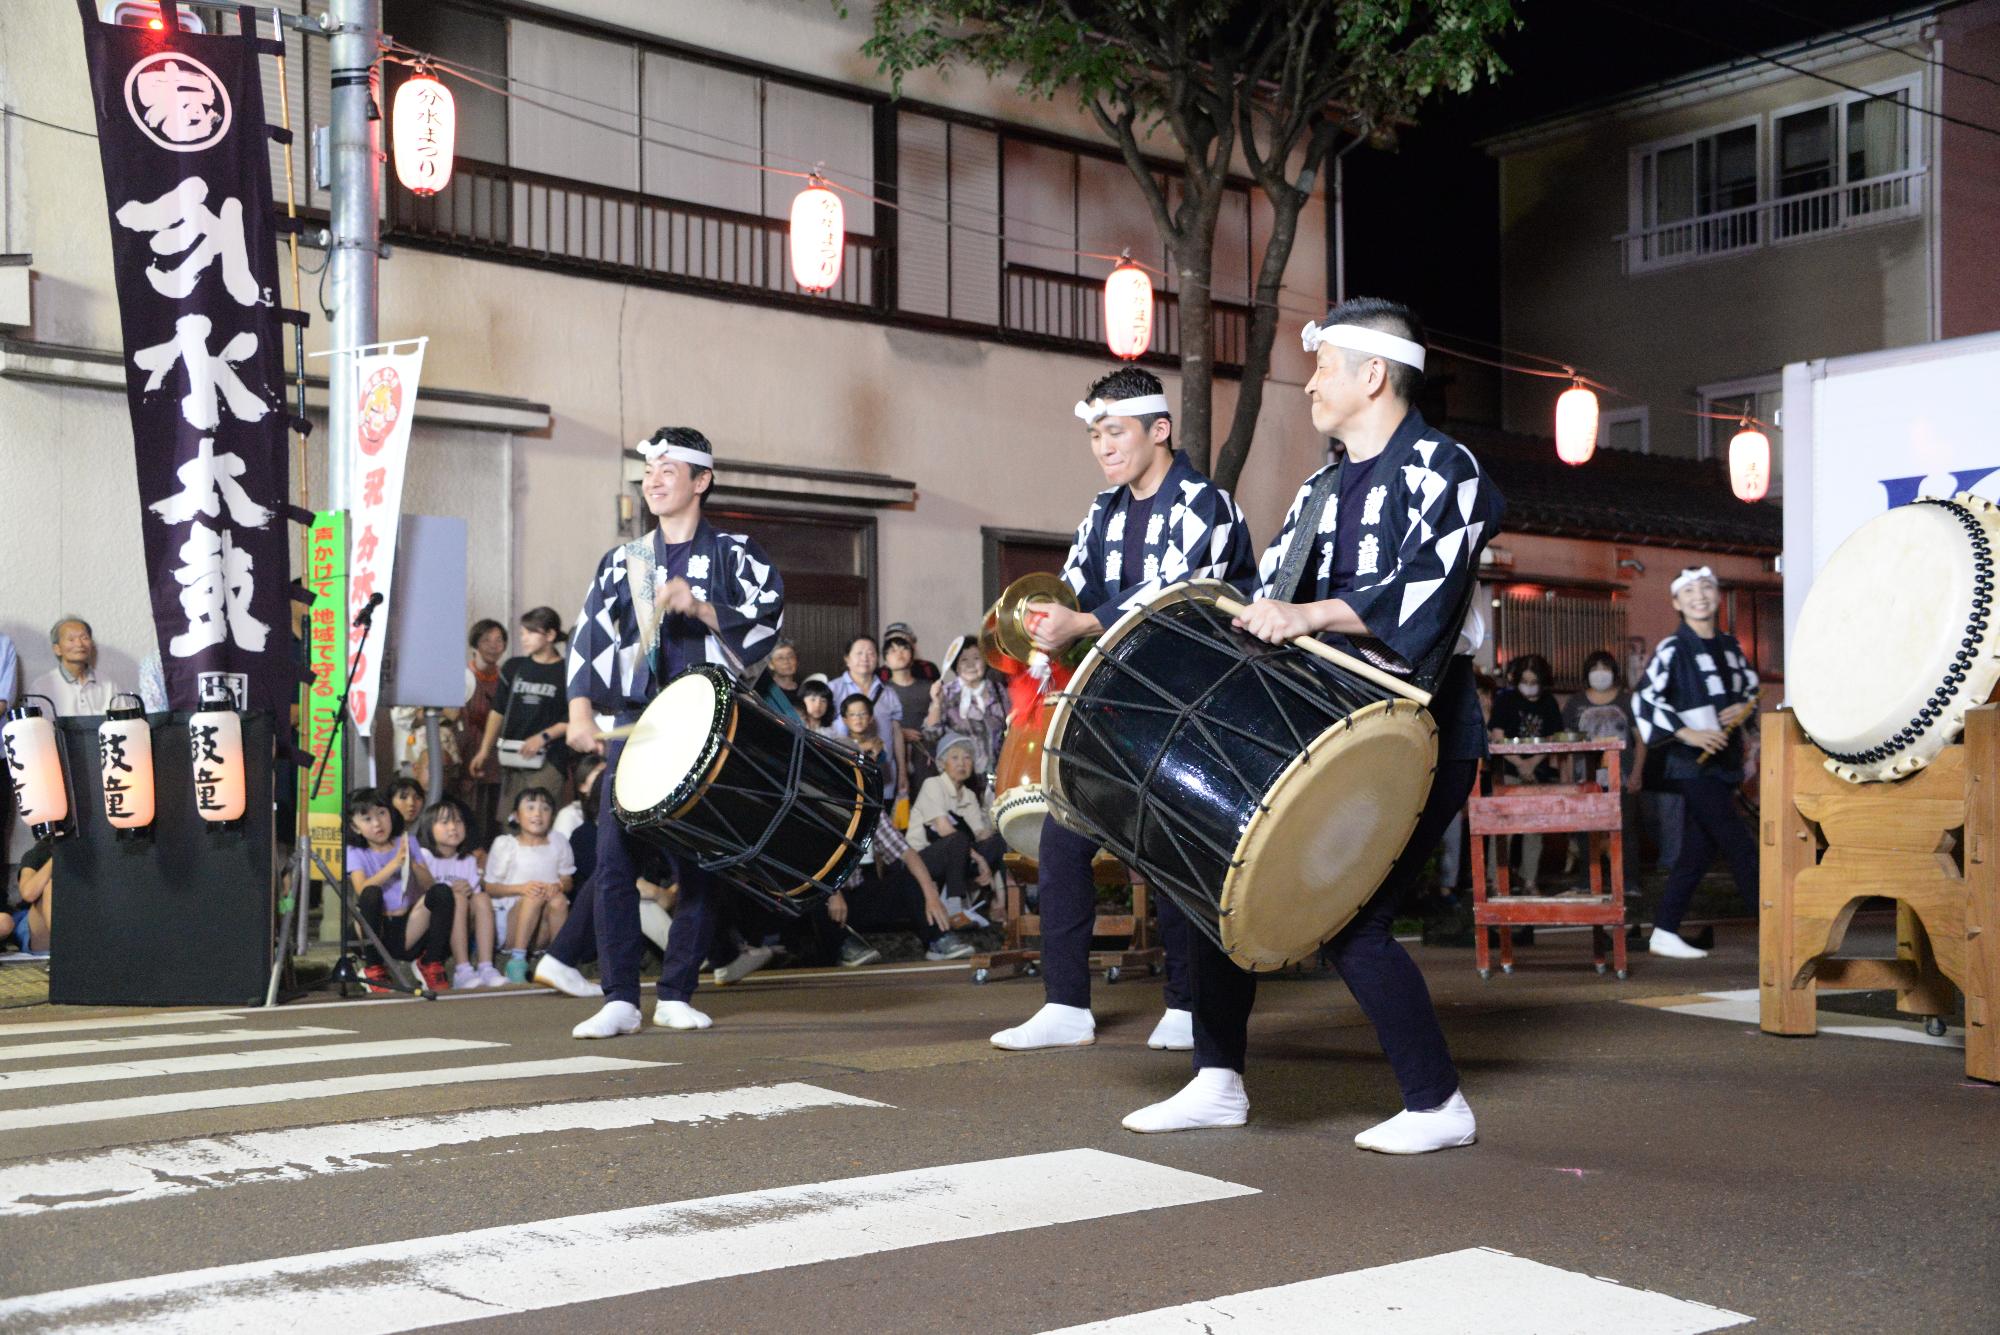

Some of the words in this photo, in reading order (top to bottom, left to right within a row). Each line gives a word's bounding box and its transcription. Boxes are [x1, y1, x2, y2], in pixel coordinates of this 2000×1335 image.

[416, 87, 444, 178] 分水まつり
[313, 526, 335, 598] 声かけて
[311, 608, 336, 697] 地域で守る
[100, 732, 135, 819] 鼓童
[190, 724, 227, 811] 鼓童
